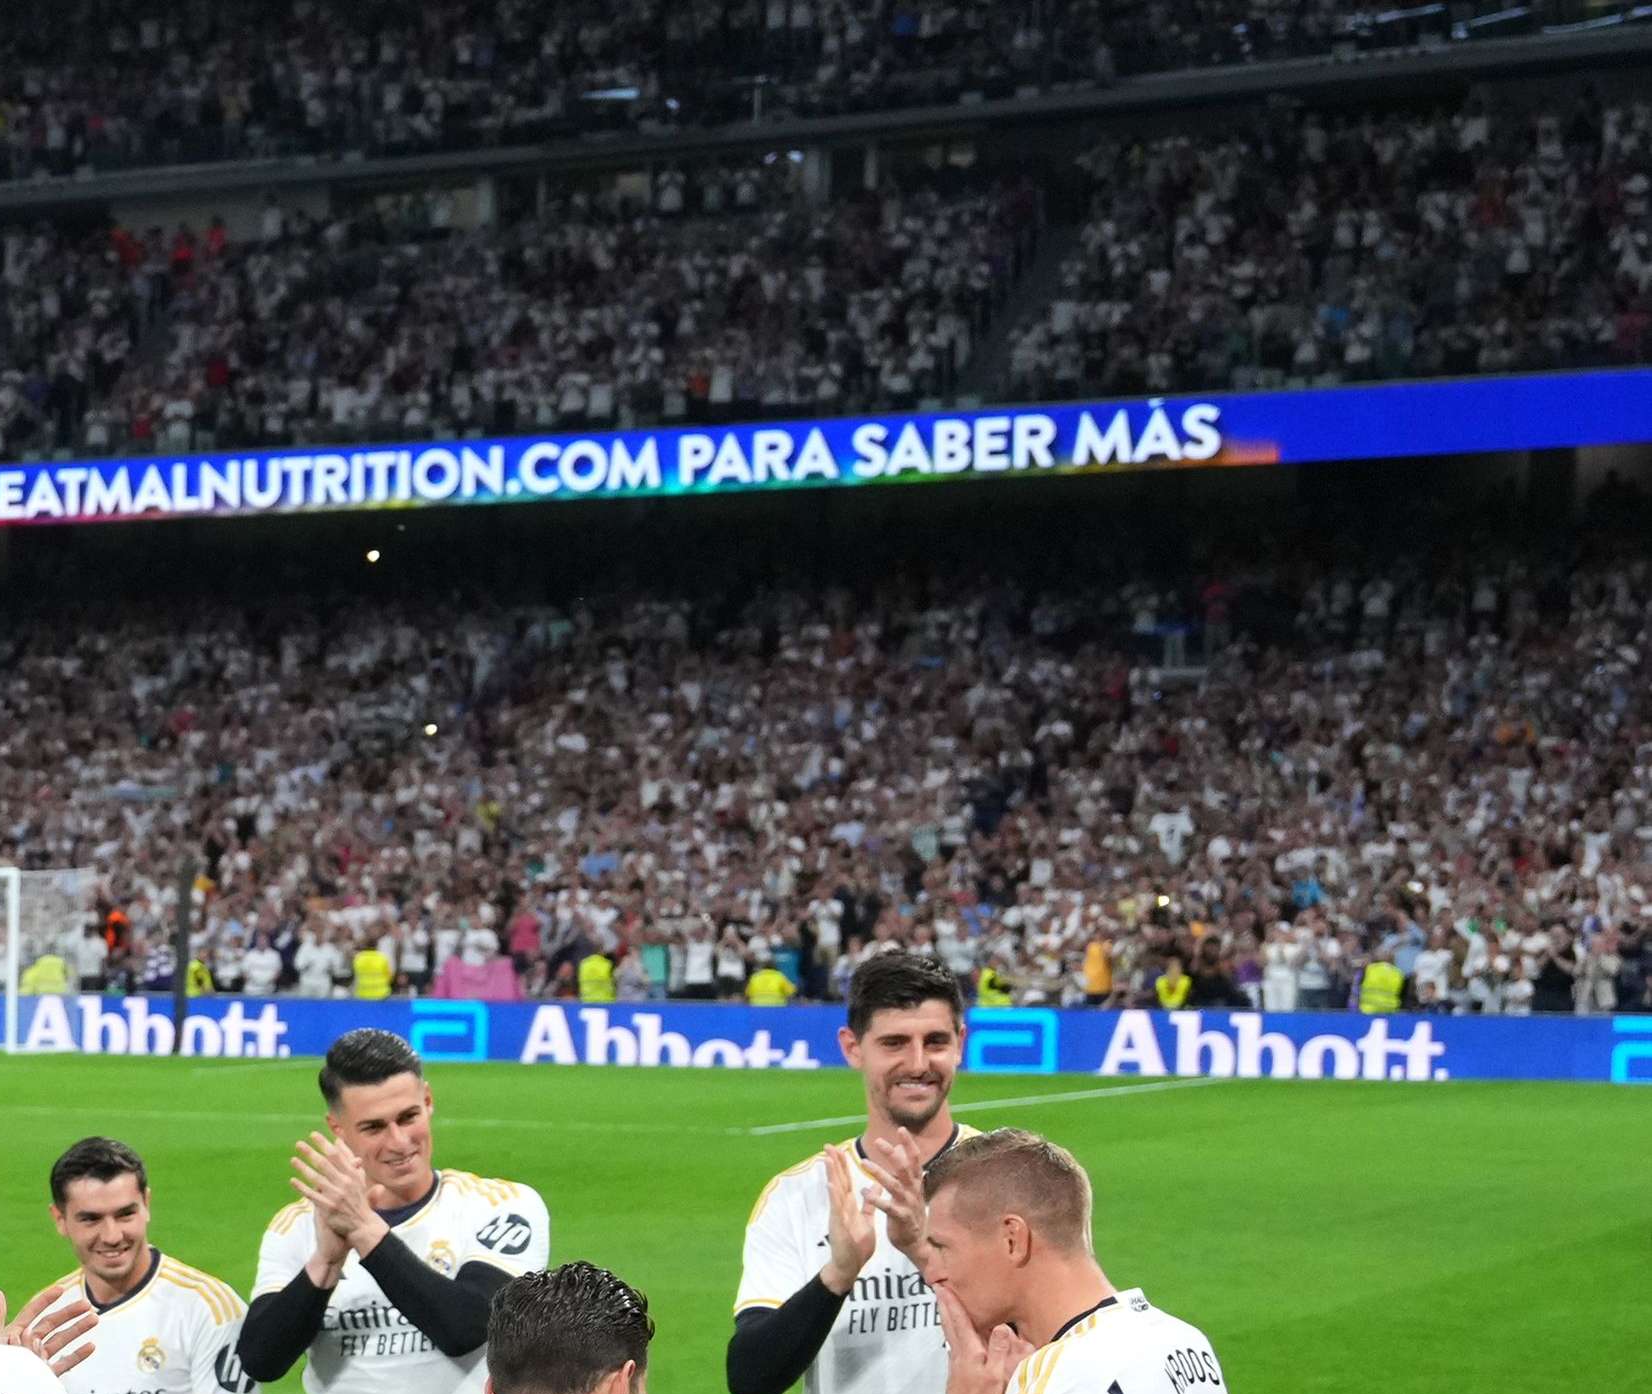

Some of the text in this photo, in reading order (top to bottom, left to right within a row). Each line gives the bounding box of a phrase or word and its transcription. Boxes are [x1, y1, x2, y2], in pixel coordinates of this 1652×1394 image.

[677, 427, 840, 487] PARA
[851, 412, 1057, 478] SABER
[1071, 398, 1223, 465] MÁS
[24, 994, 292, 1059] Abbott
[521, 1003, 820, 1070] Abbott
[1097, 1009, 1450, 1082] Abbott
[848, 1266, 934, 1302] mira
[321, 1299, 410, 1331] Emira
[848, 1301, 942, 1335] FLY BETTE
[339, 1329, 436, 1358] FLY BETTE
